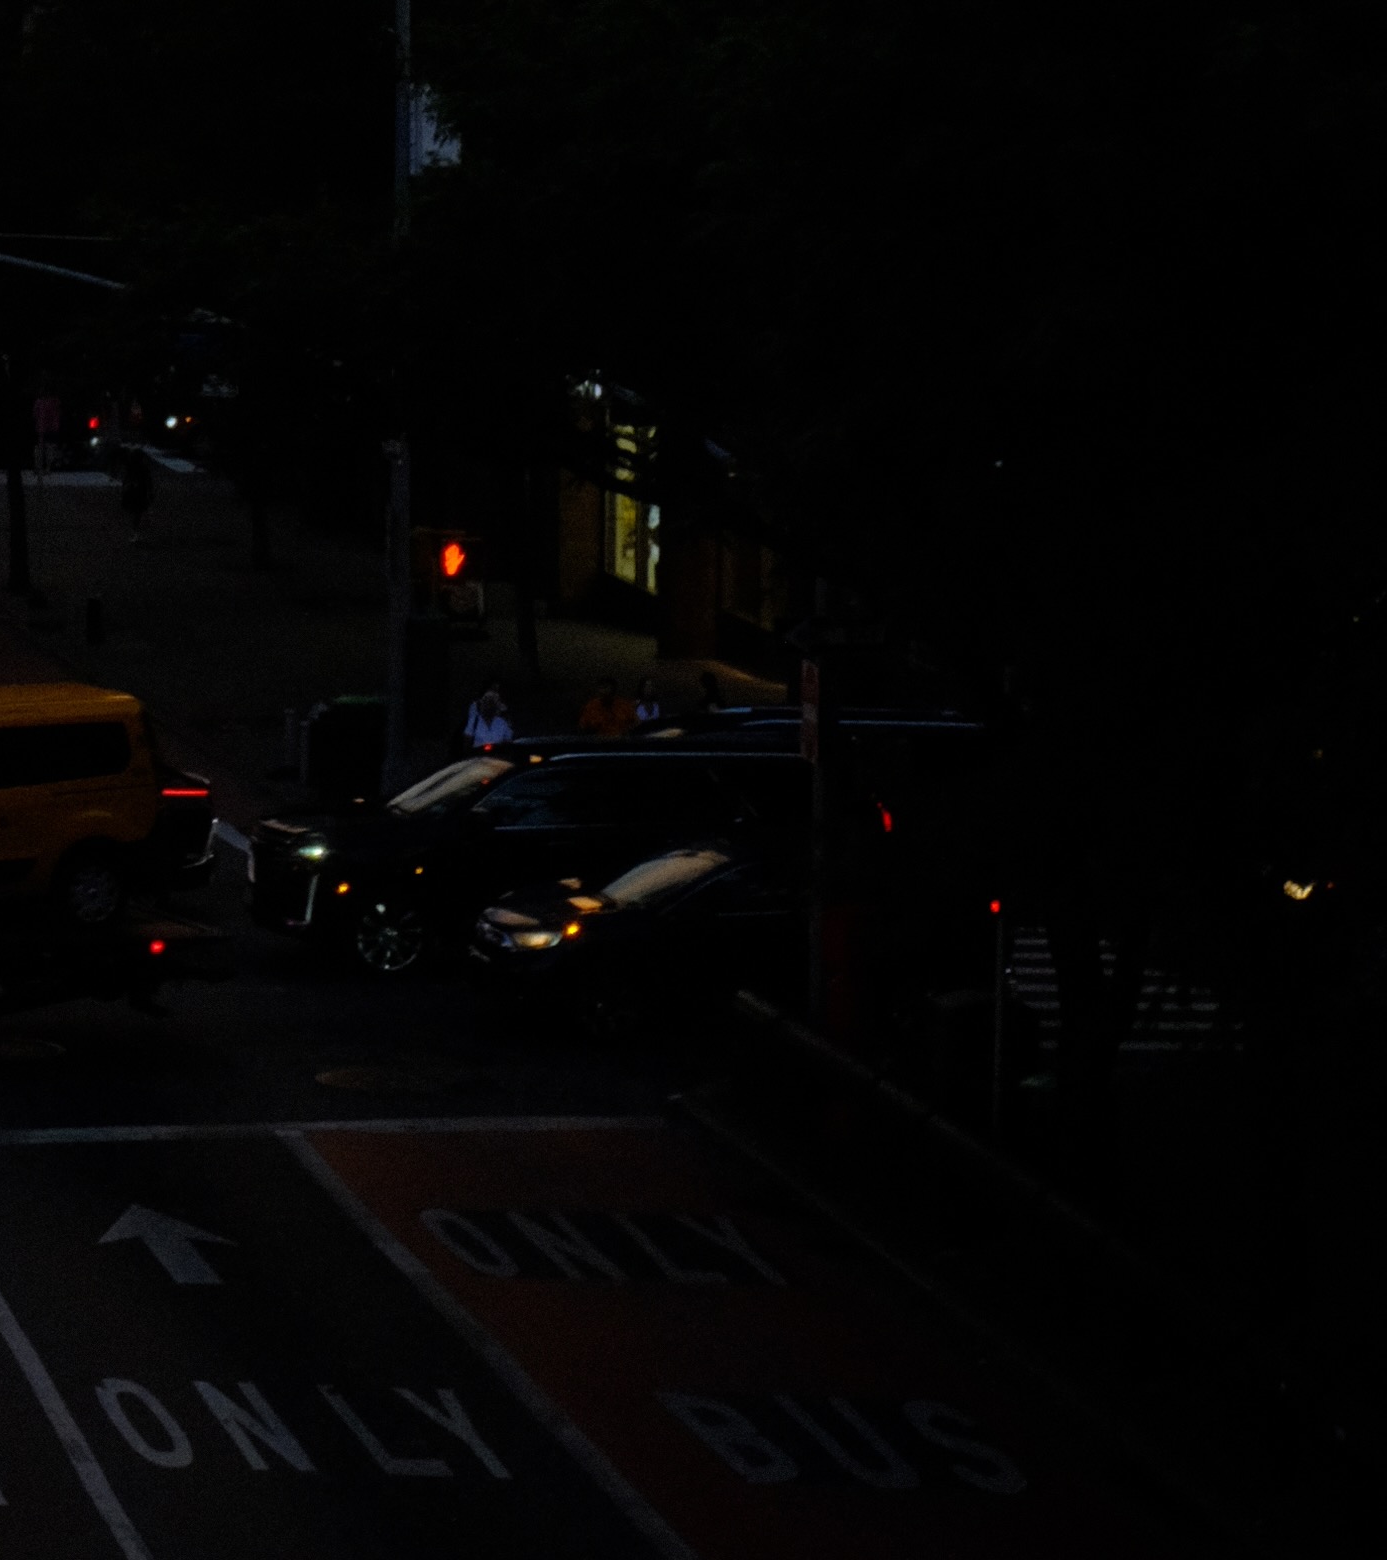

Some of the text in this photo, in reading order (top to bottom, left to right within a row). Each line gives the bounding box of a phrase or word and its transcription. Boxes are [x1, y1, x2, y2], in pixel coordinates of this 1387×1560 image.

[418, 1206, 792, 1288] ONLY
[93, 1376, 513, 1482] ONLY
[657, 1390, 1030, 1496] BUS
